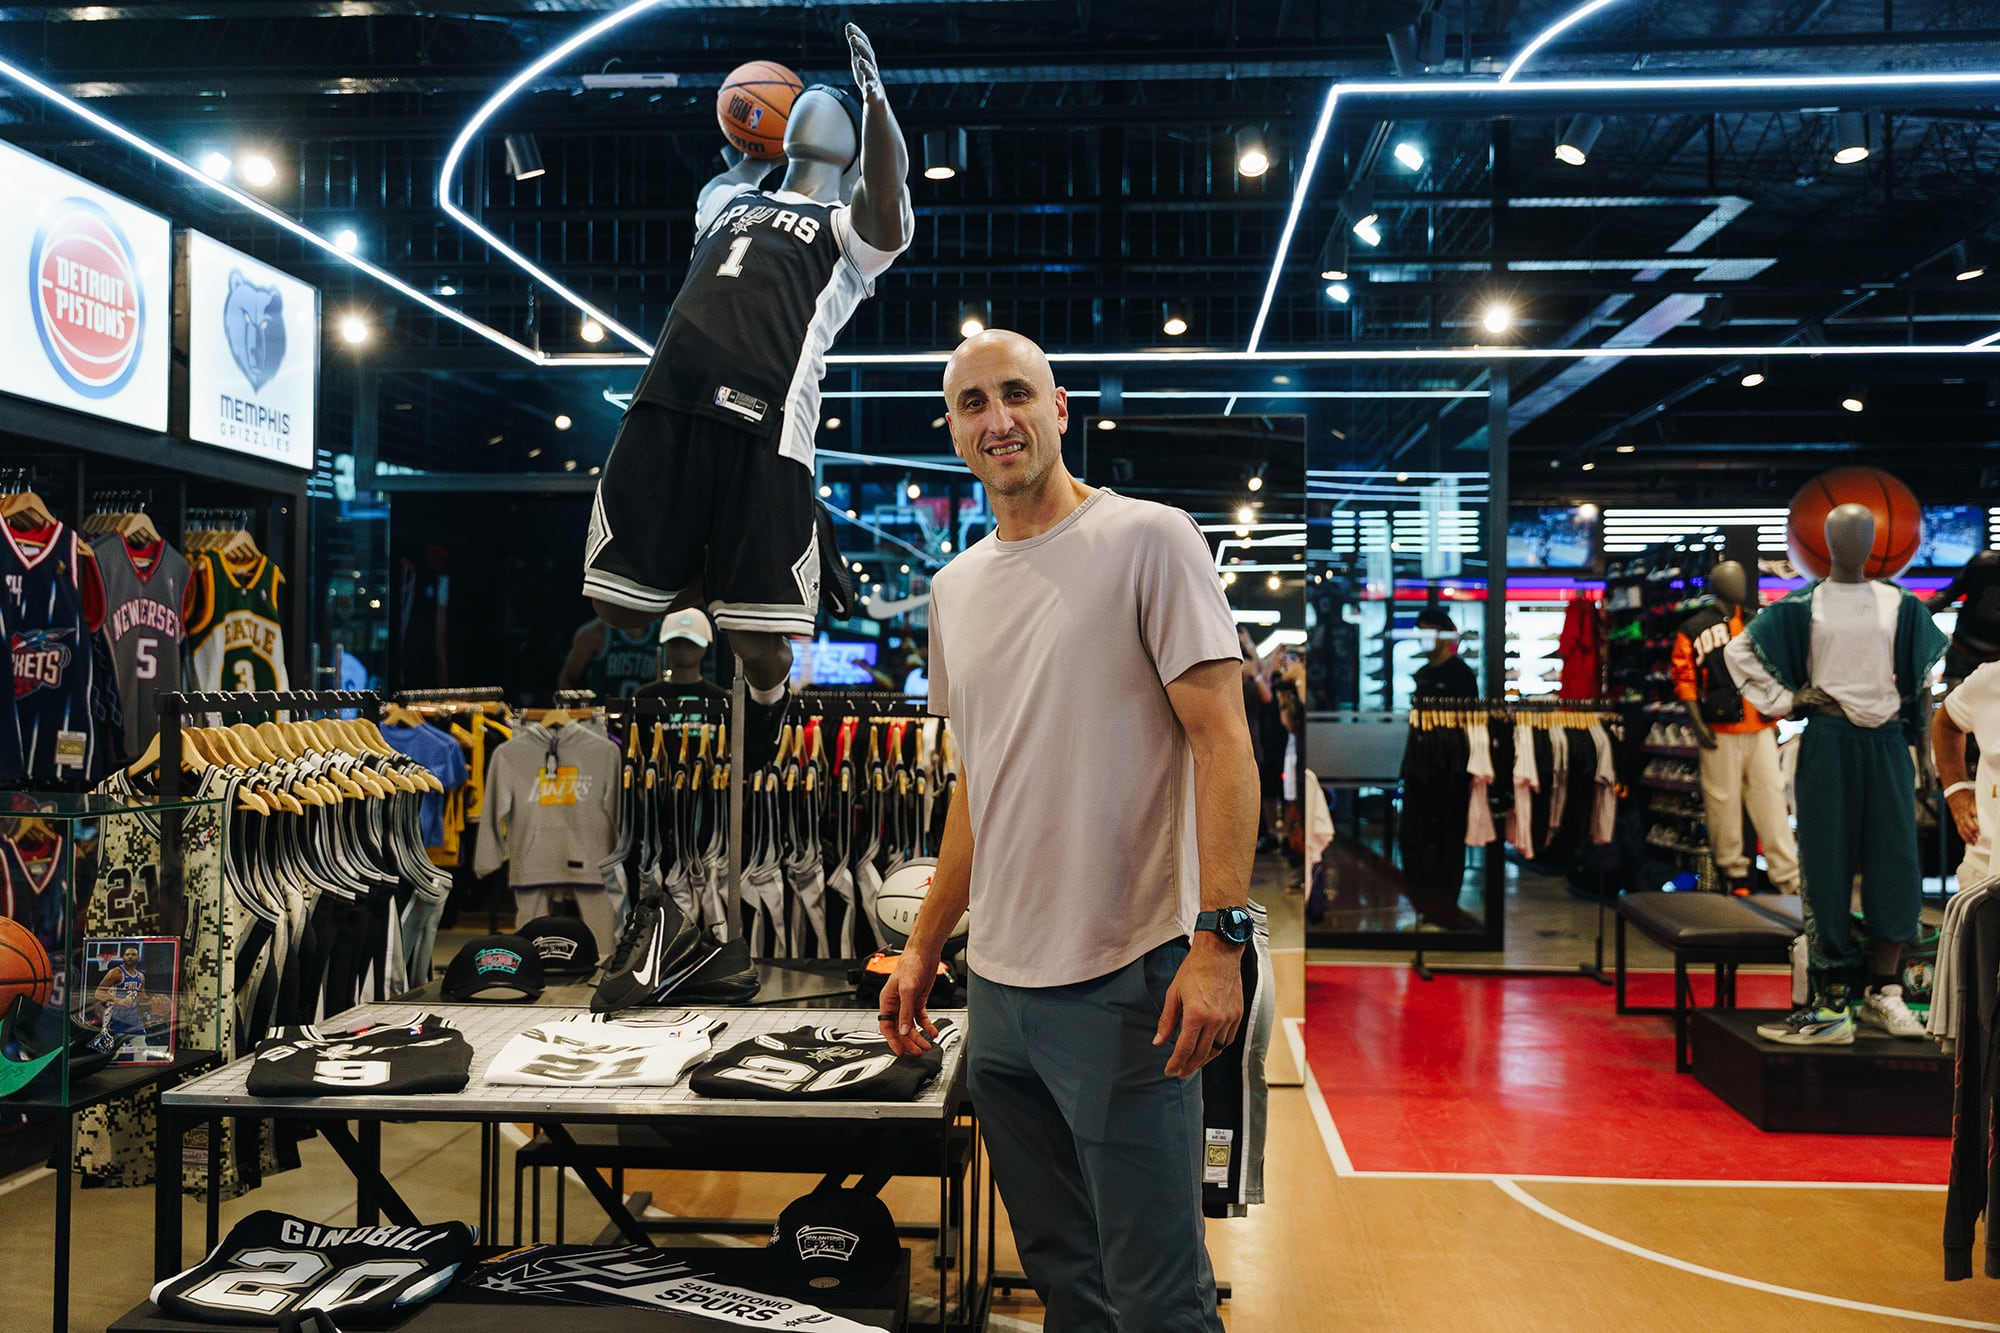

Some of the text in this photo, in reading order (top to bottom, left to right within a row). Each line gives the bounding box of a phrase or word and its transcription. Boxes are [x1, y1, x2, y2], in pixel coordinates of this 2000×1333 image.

[716, 236, 753, 279] 1
[56, 256, 125, 306] DETROIT
[56, 290, 126, 339] PISTONS
[220, 394, 290, 435] MEMPHIS
[220, 424, 290, 452] GRIZZLIES
[136, 637, 159, 680] 5
[233, 659, 256, 692] 3
[105, 863, 161, 922] 21
[312, 1060, 392, 1087] 9
[515, 1053, 650, 1082] 21
[713, 1053, 899, 1093] 20
[281, 1218, 450, 1252] GINOBILI
[177, 1247, 430, 1316] 20
[678, 1281, 793, 1311] SAN ANTONIO
[654, 1288, 781, 1323] SPURS
